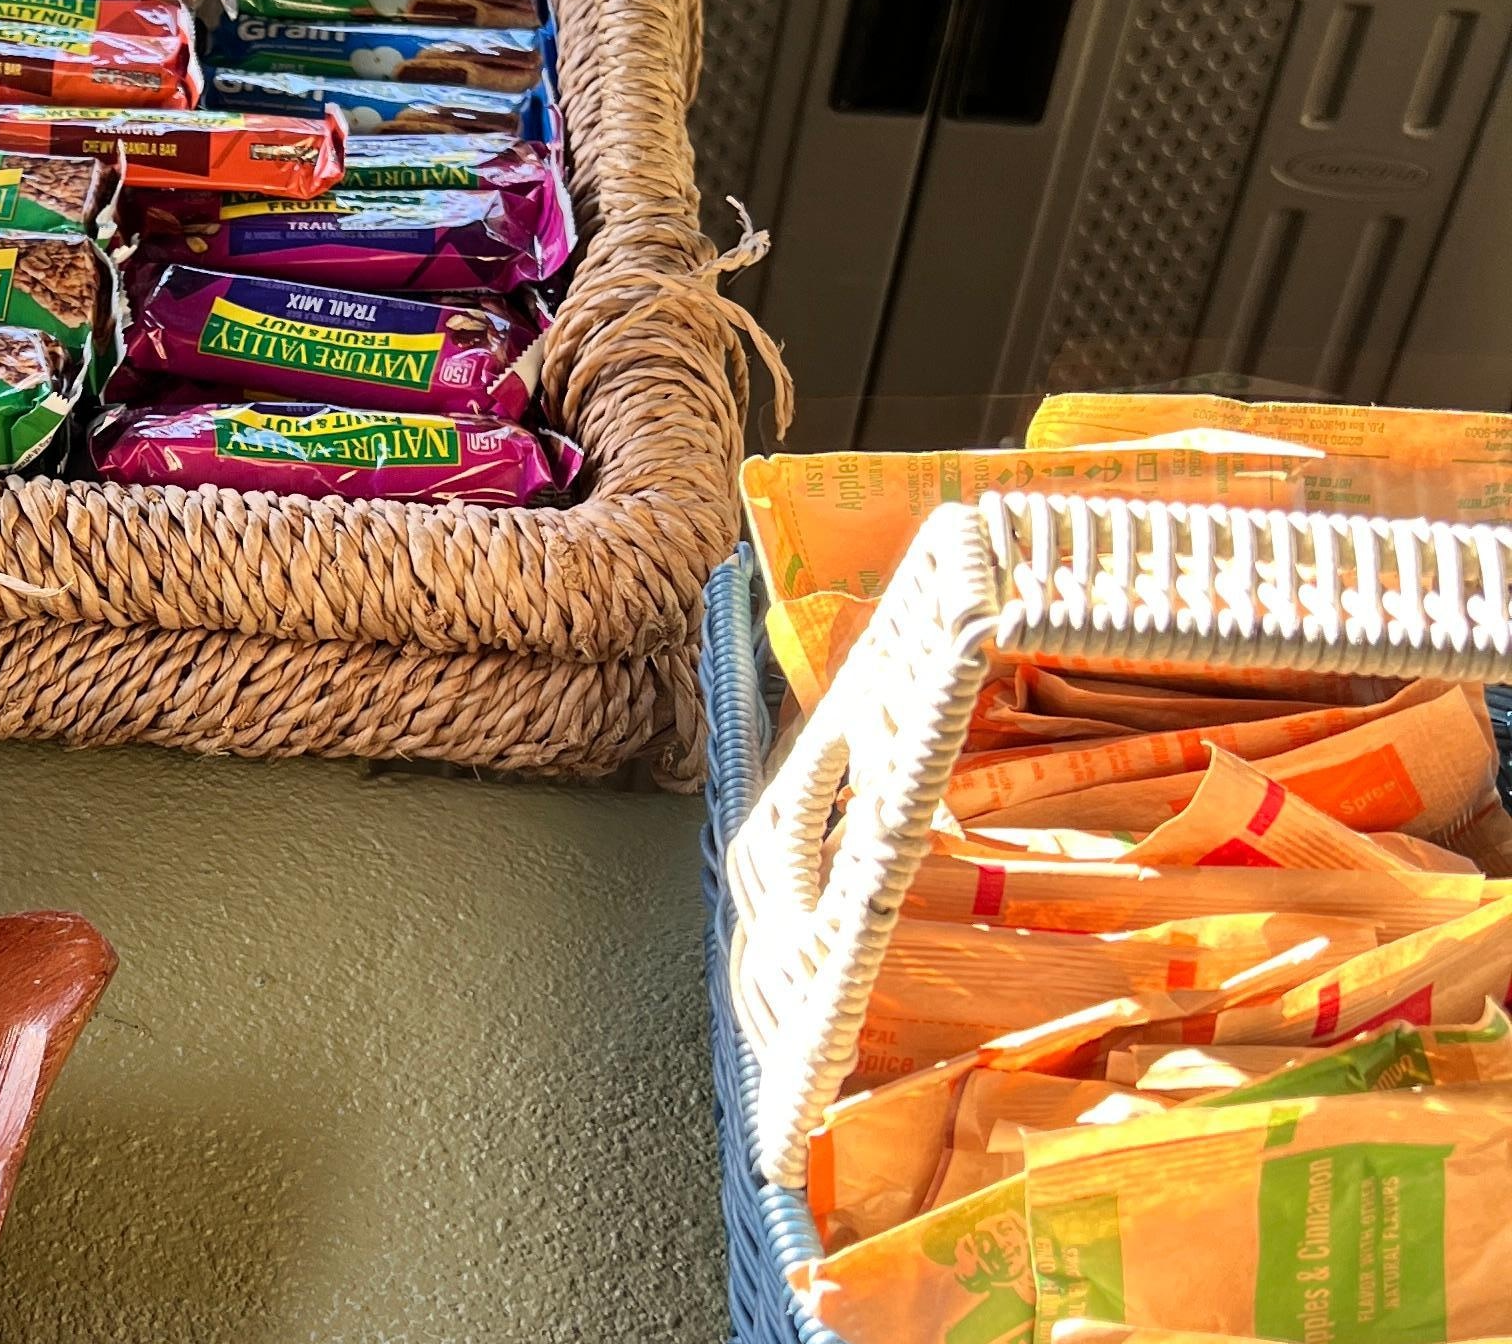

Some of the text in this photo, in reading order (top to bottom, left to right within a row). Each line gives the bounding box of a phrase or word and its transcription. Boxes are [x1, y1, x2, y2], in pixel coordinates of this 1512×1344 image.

[42, 12, 84, 29] NUT
[3, 63, 23, 76] BAR
[160, 144, 178, 157] BAR
[267, 199, 332, 212] FRUIT
[287, 221, 336, 231] TRAIL
[286, 293, 324, 313] MIX
[328, 299, 378, 322] TRAIL
[255, 316, 305, 334] NUT
[309, 328, 318, 337] &
[321, 330, 391, 347] FRUIT
[207, 321, 429, 383] NATURE VALLEY
[442, 366, 473, 384] 150
[260, 416, 317, 435] NUT
[336, 427, 450, 462] NATURE
[943, 457, 959, 482] 2/3
[1296, 1157, 1333, 1282] & Cinnamon
[1382, 1174, 1401, 1309] NATURAL FLAVORS
[1357, 1269, 1377, 1323] FLAVOR
